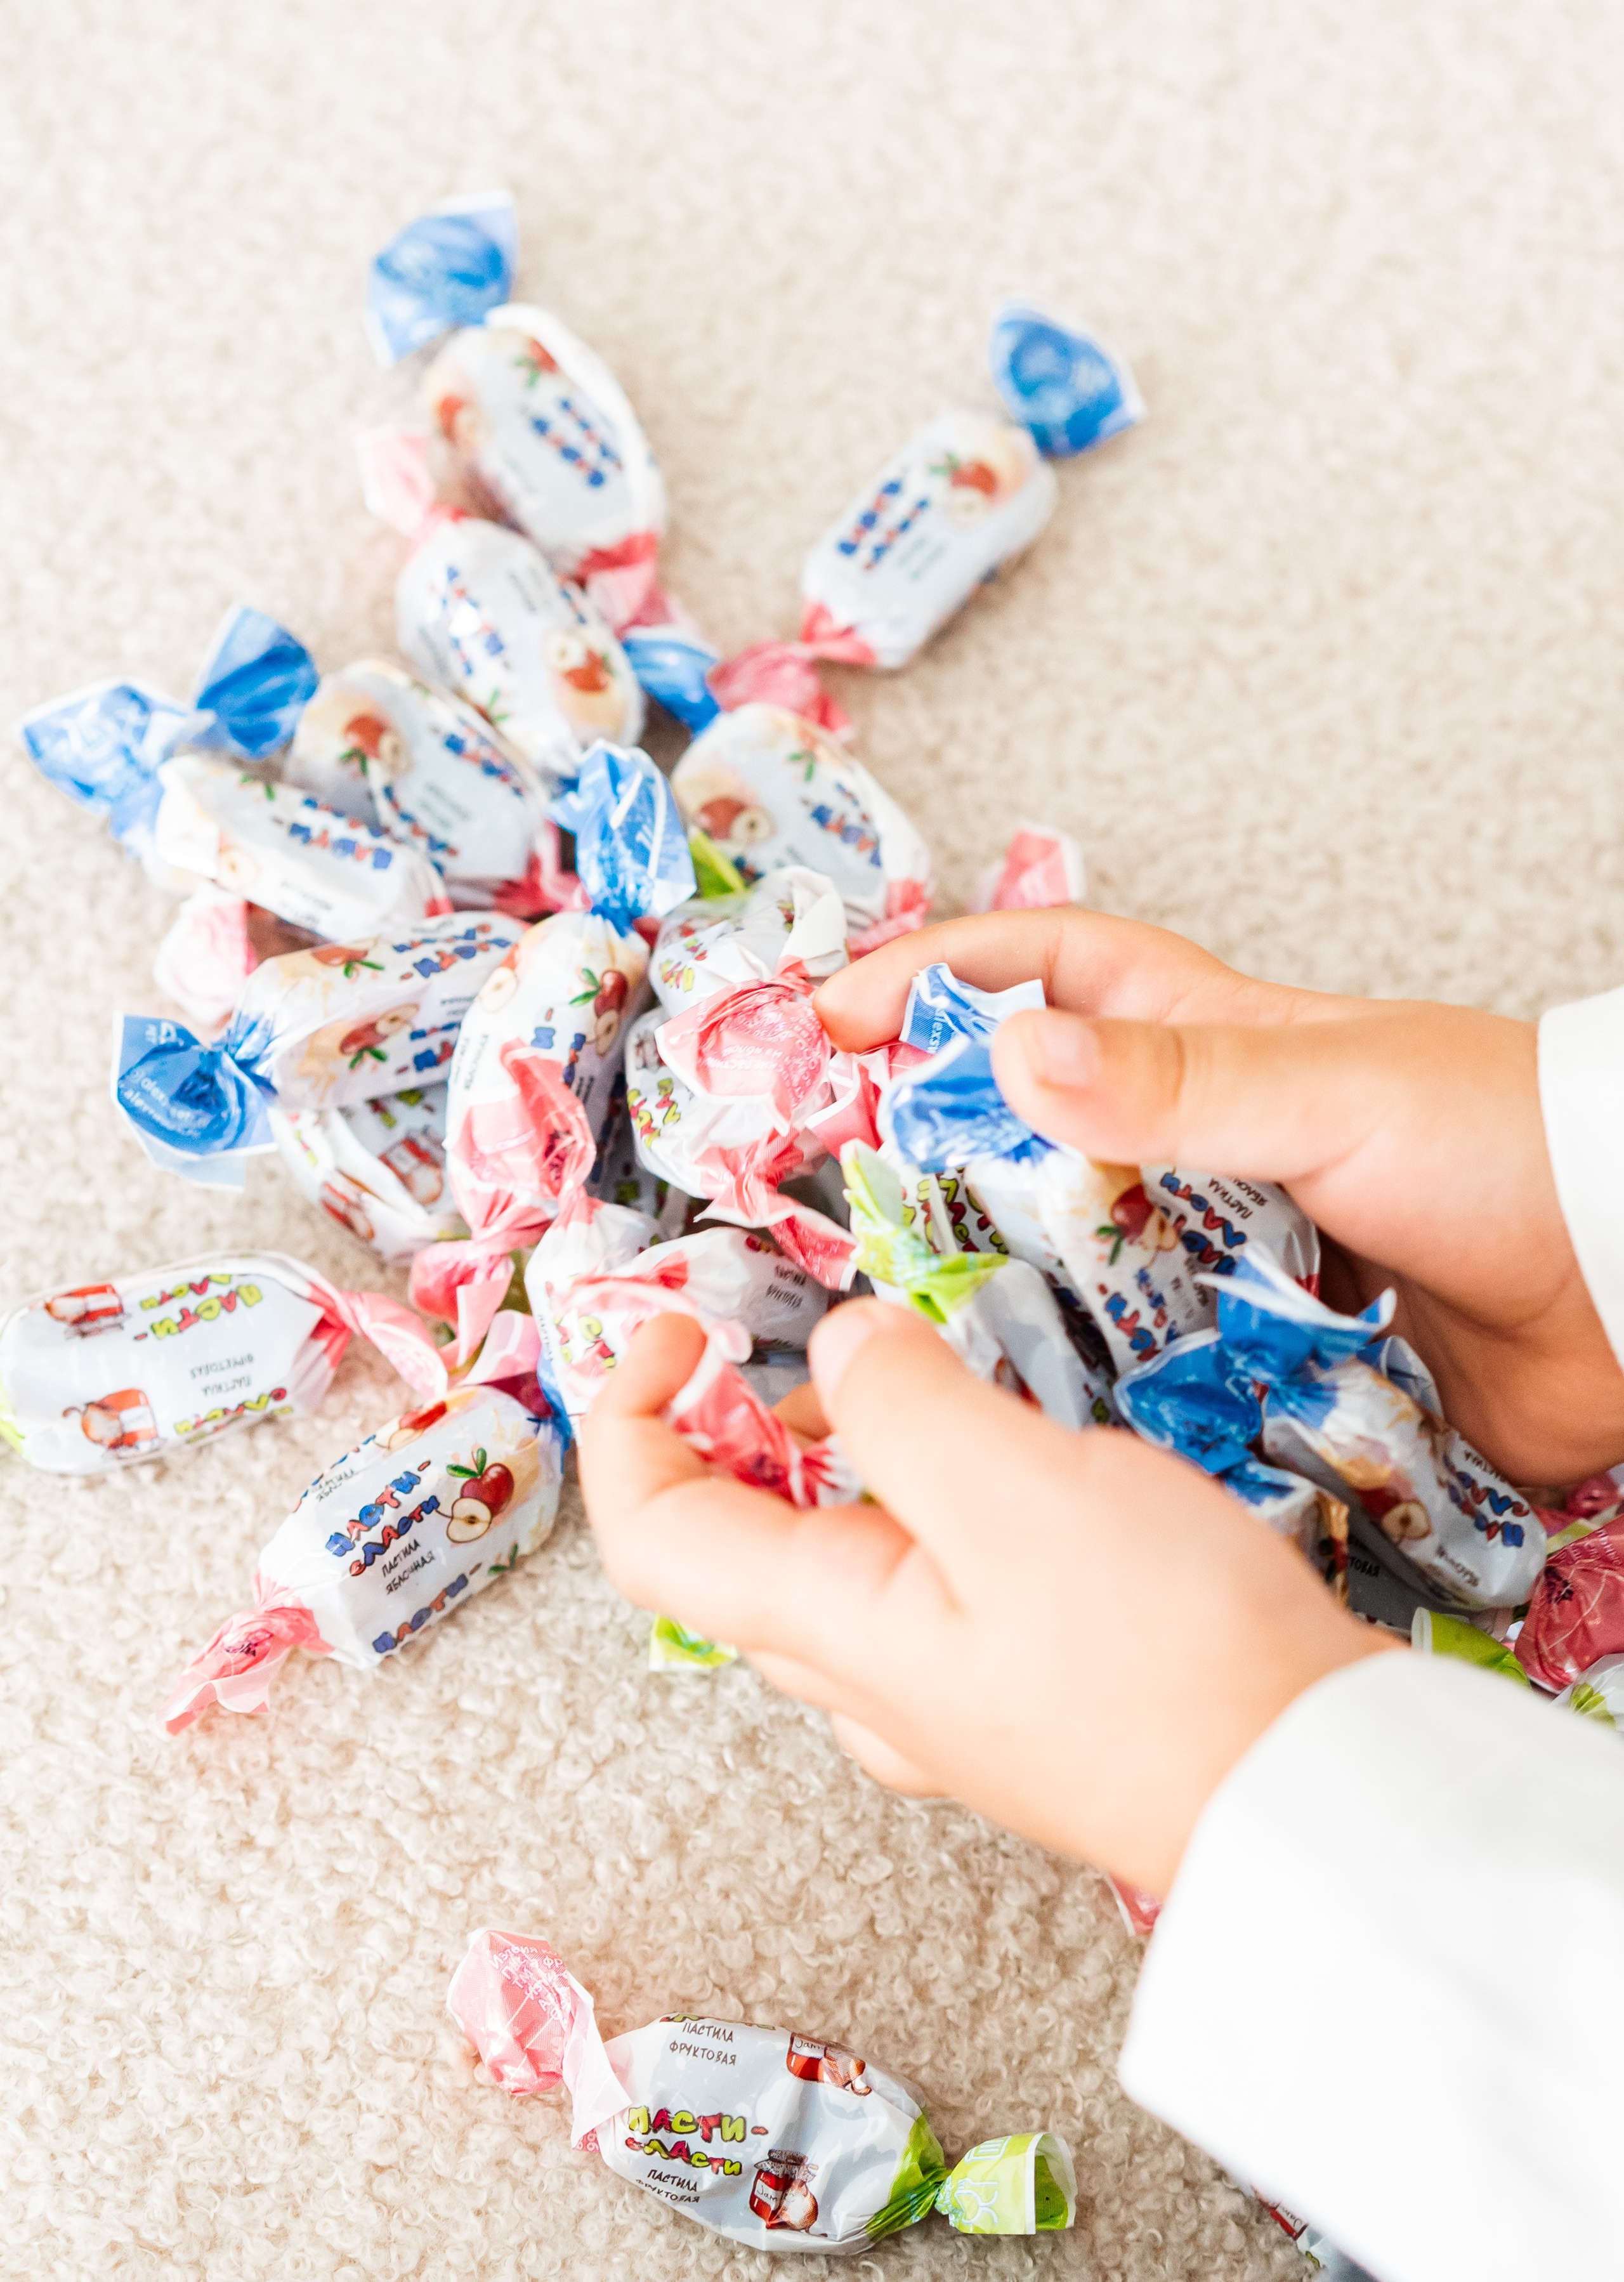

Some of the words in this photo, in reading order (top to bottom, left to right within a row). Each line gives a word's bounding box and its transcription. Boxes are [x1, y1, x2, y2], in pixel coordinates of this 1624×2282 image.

[1208, 1177, 1253, 1219] ПАСТИЛА
[324, 1459, 432, 1558] ПАСТИ-
[350, 1495, 441, 1577] СЛАСТИ
[381, 1538, 421, 1578] ПАСТИЛА
[682, 2022, 735, 2043] ПАСТИЛА
[669, 2040, 738, 2066] ФРУКТОВАЯ
[627, 2104, 769, 2144] ПАСТИ-
[625, 2136, 743, 2177] СЛАСТИ
[647, 2168, 698, 2193] ПАСТИЛА
[756, 2184, 779, 2204] Jam
